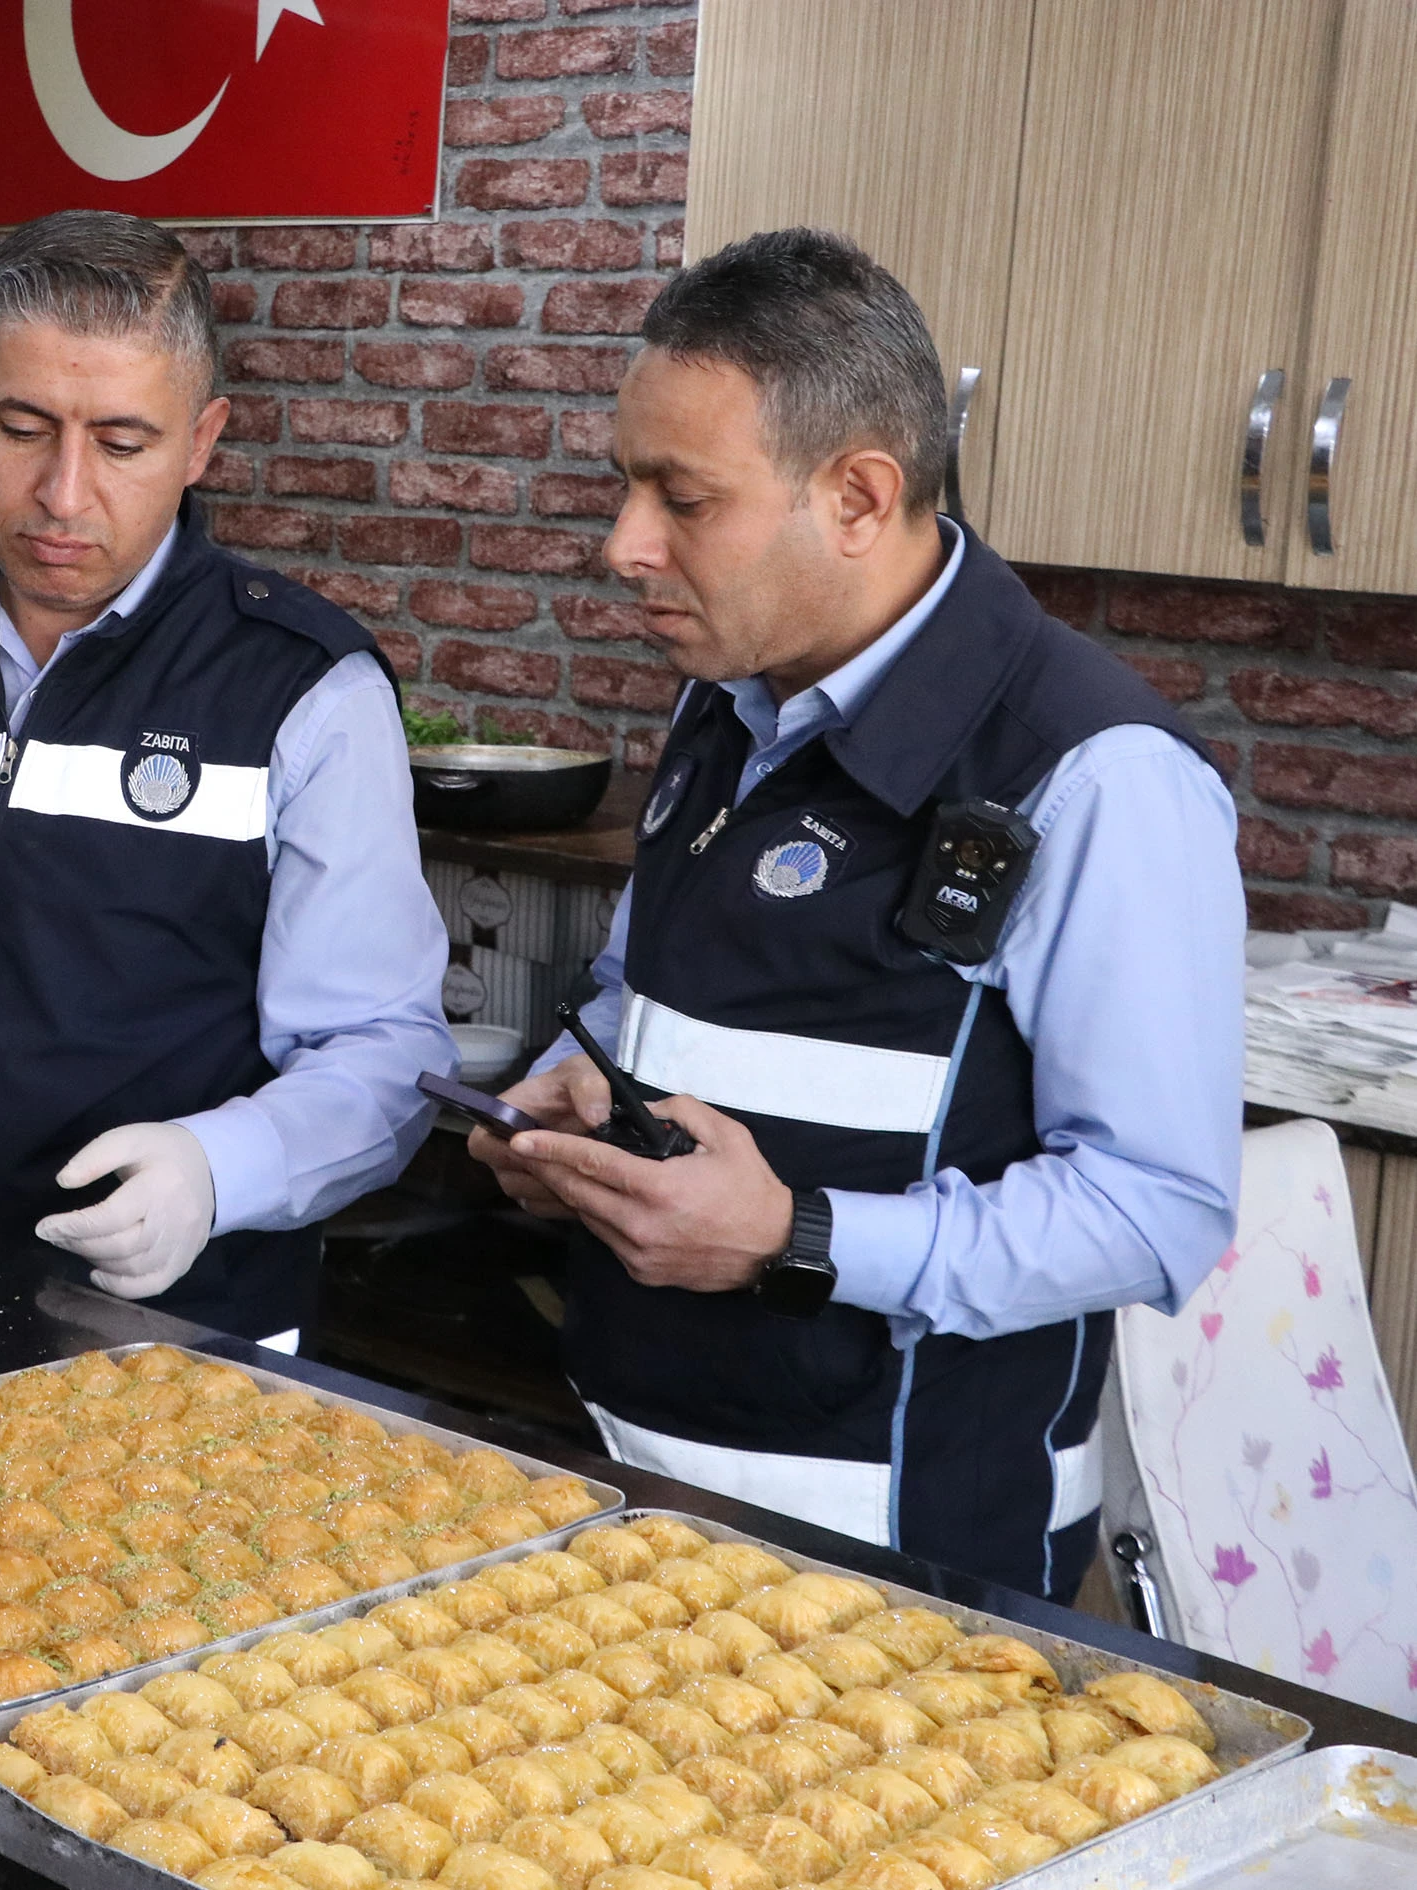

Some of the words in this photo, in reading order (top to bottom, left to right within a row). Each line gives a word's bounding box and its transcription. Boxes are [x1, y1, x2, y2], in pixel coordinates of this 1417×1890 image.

[140, 731, 190, 753] ZABITA
[800, 815, 847, 851] ZABITA
[937, 885, 978, 910] AFRA
